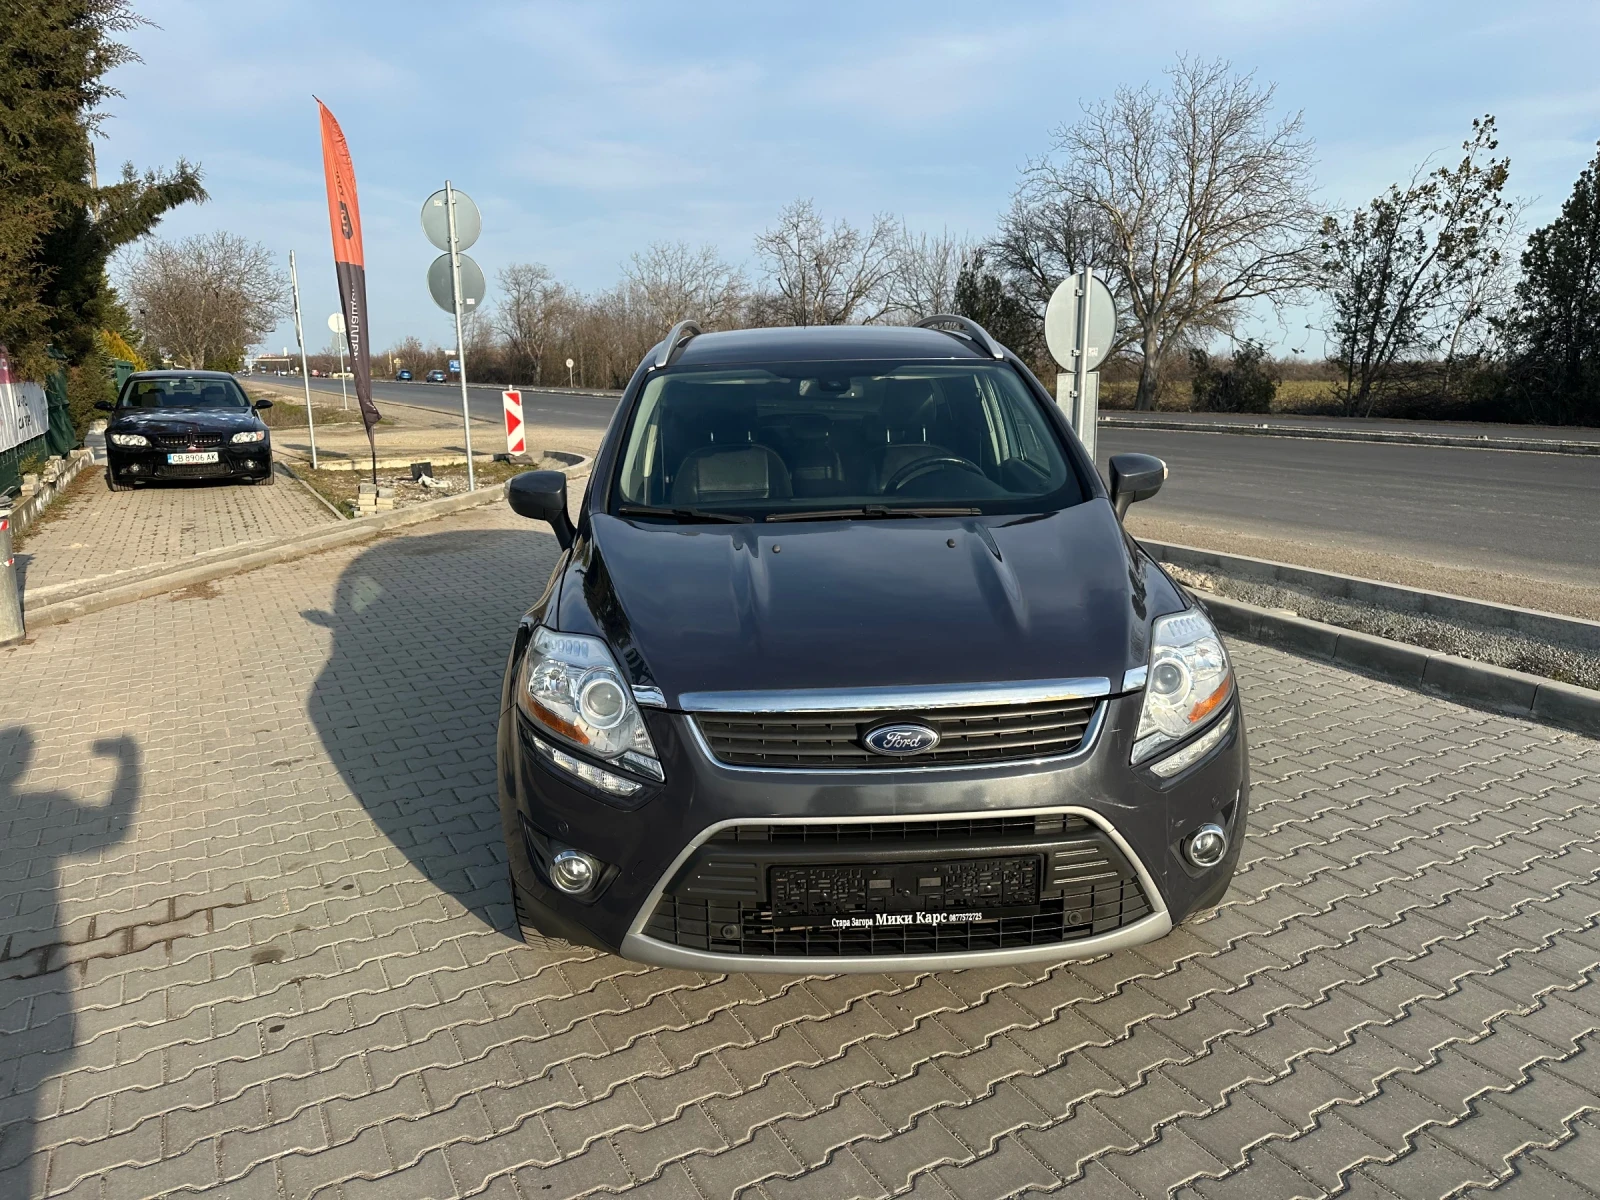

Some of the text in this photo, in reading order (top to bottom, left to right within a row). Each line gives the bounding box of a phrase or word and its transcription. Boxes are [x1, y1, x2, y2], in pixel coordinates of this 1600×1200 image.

[883, 731, 921, 748] Ford
[831, 918, 851, 929] Стара
[851, 917, 873, 928] Загора
[875, 913, 913, 926] Мики
[915, 911, 947, 926] Карс
